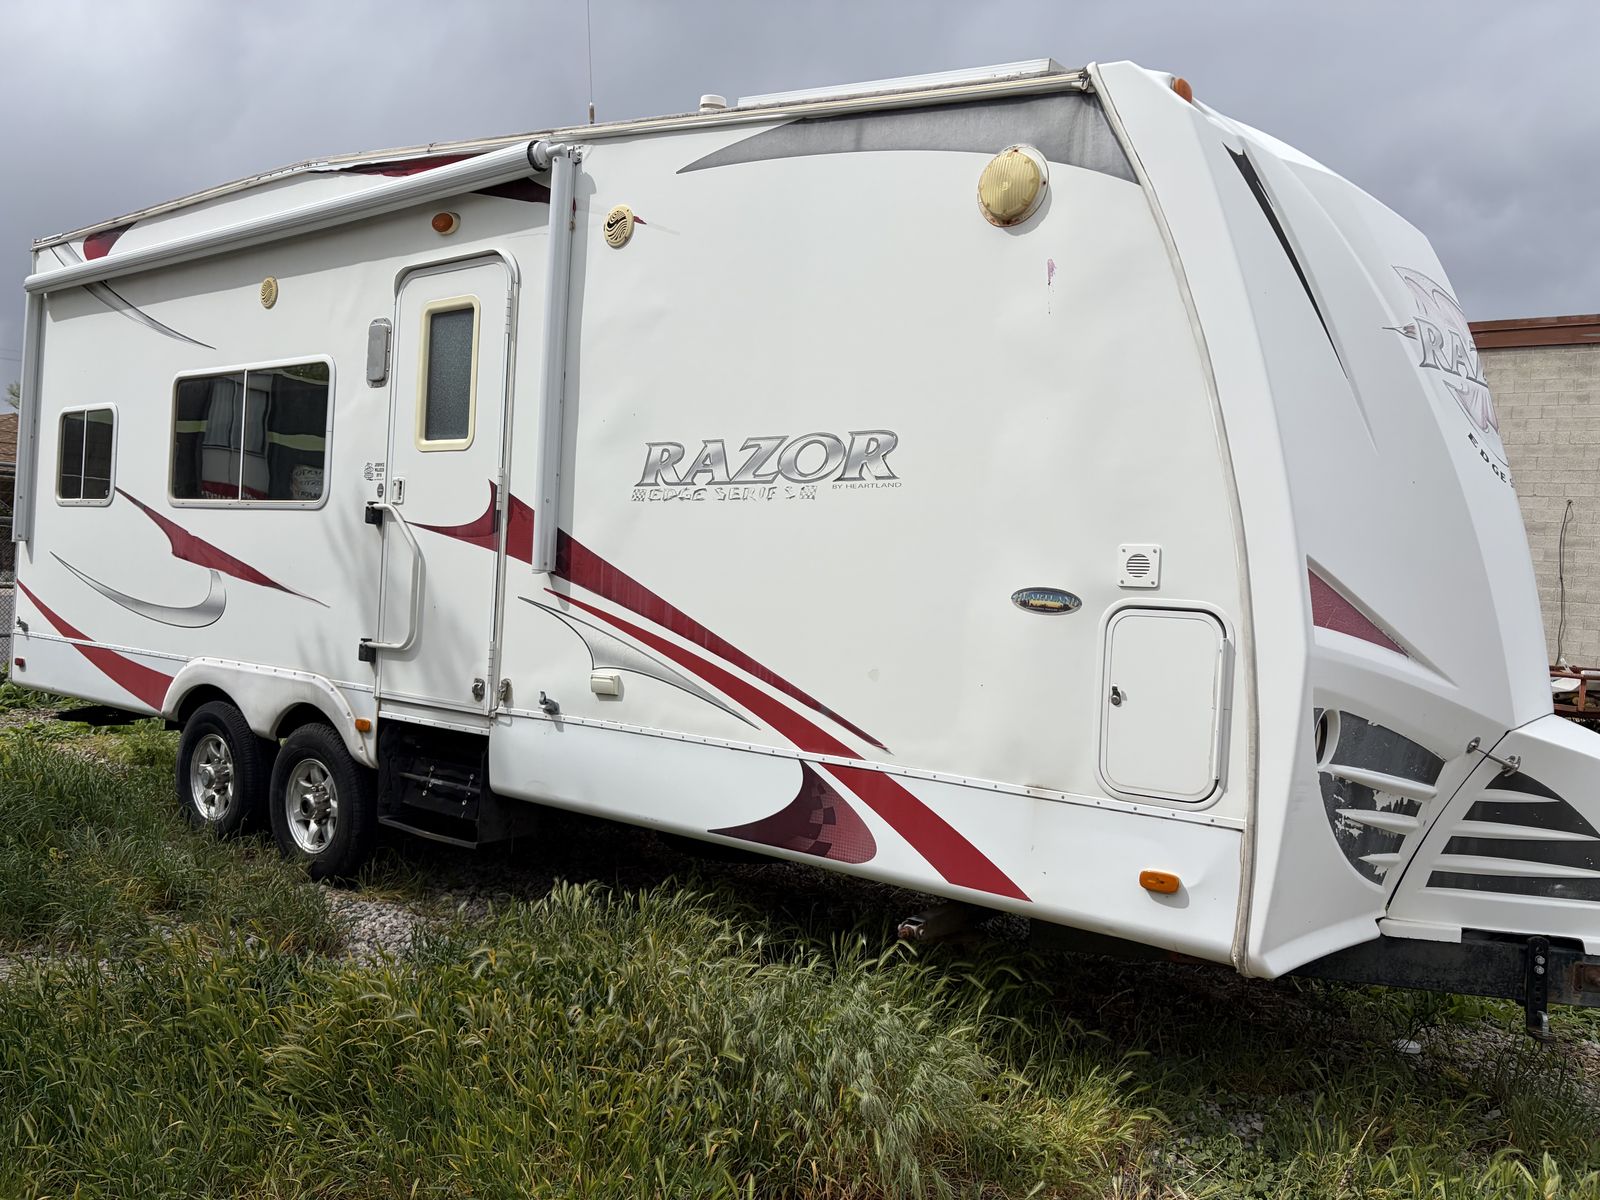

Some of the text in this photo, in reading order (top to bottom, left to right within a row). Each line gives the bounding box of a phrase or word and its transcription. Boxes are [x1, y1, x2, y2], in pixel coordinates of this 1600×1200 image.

[635, 429, 900, 487] RAZOR
[1468, 432, 1507, 484] EDGE
[649, 488, 707, 501] EDGE
[845, 482, 903, 490] HEARTLAND
